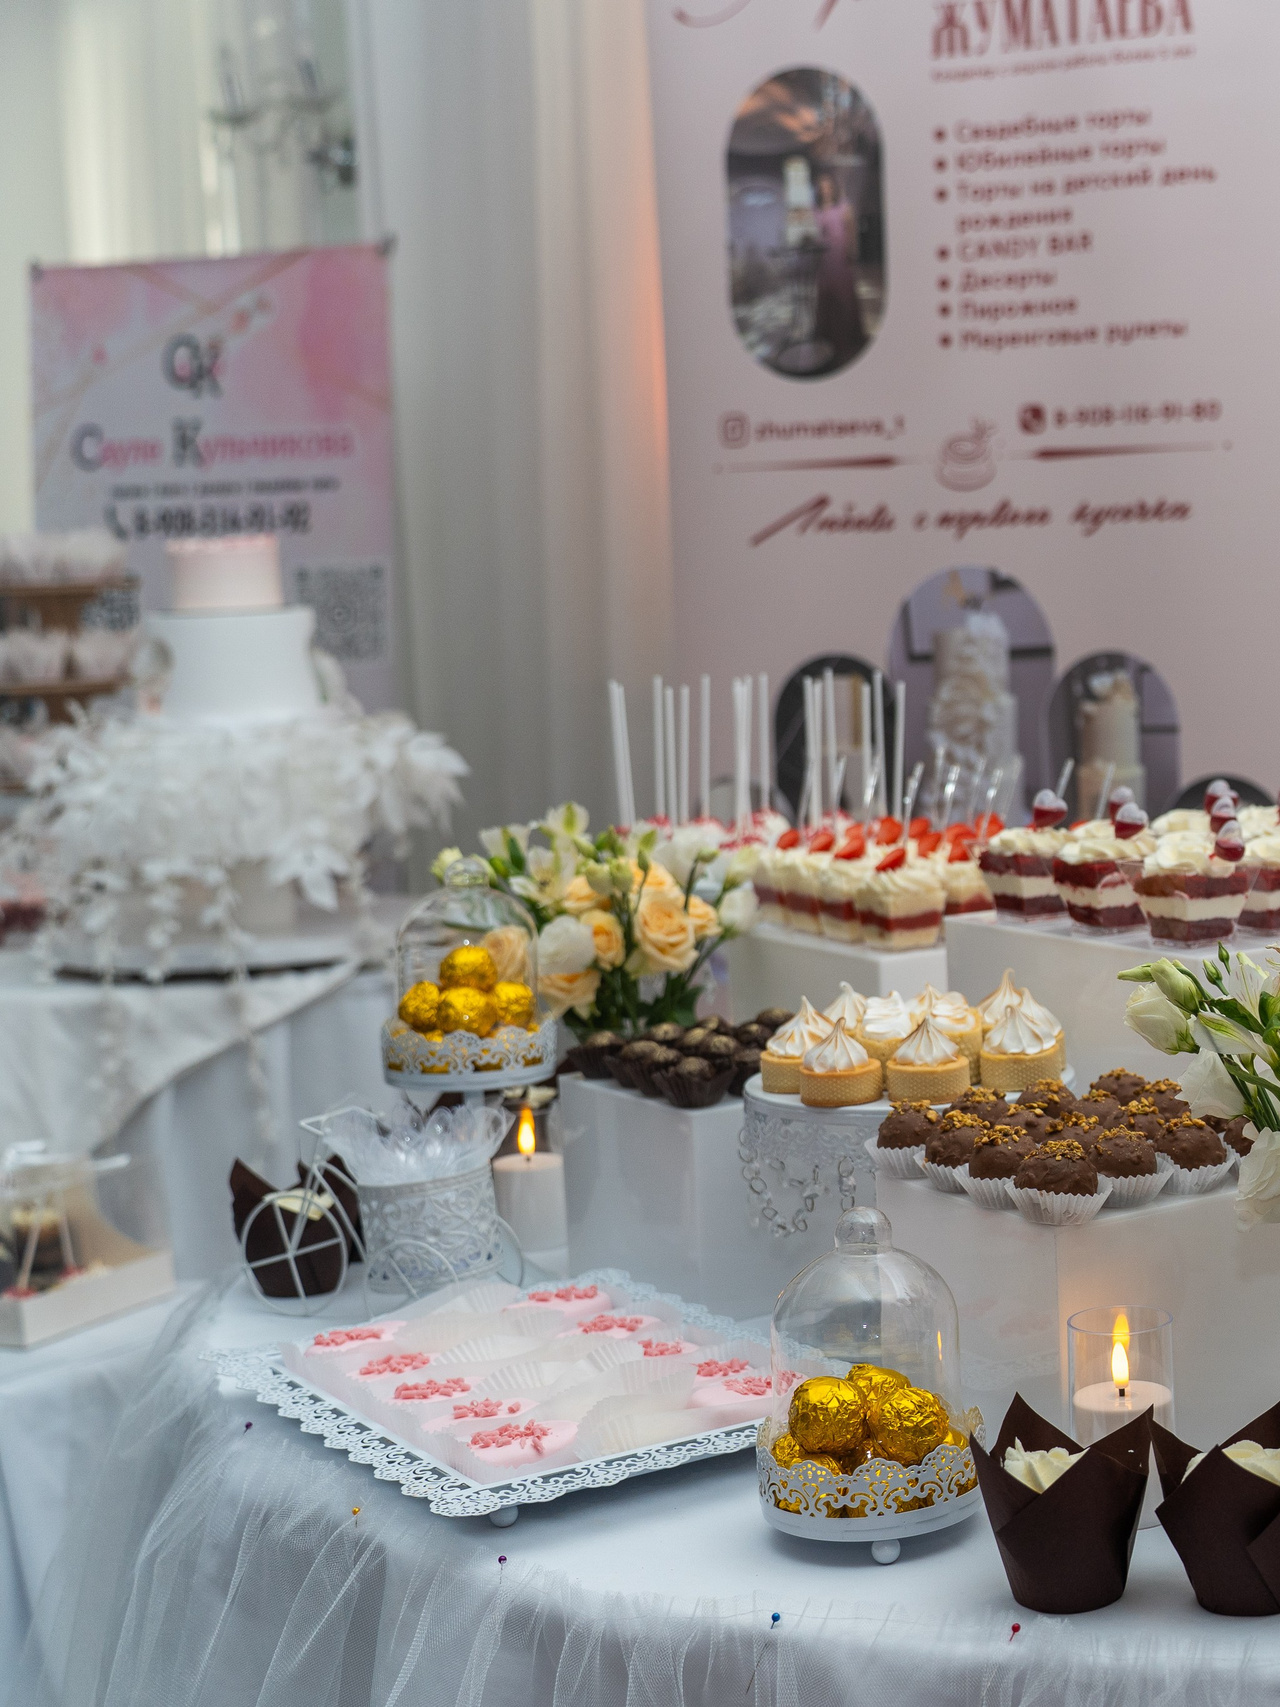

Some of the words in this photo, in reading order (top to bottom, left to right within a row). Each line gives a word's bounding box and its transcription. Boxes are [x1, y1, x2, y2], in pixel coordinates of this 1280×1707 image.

[955, 116, 1079, 142] Свадебные
[1086, 110, 1150, 131] торты
[955, 146, 1092, 171] Юбилейные
[1100, 140, 1165, 160] торты
[957, 182, 1023, 203] Торты
[1030, 182, 1056, 195] на
[1062, 168, 1152, 195] детский
[1160, 168, 1217, 187] день
[957, 208, 1074, 235] рождения
[957, 239, 1040, 262] CANDY
[1048, 232, 1092, 254] BAR
[958, 270, 1056, 294] Десерты
[961, 327, 1099, 350] Меренговые
[1105, 322, 1187, 345] рулеты
